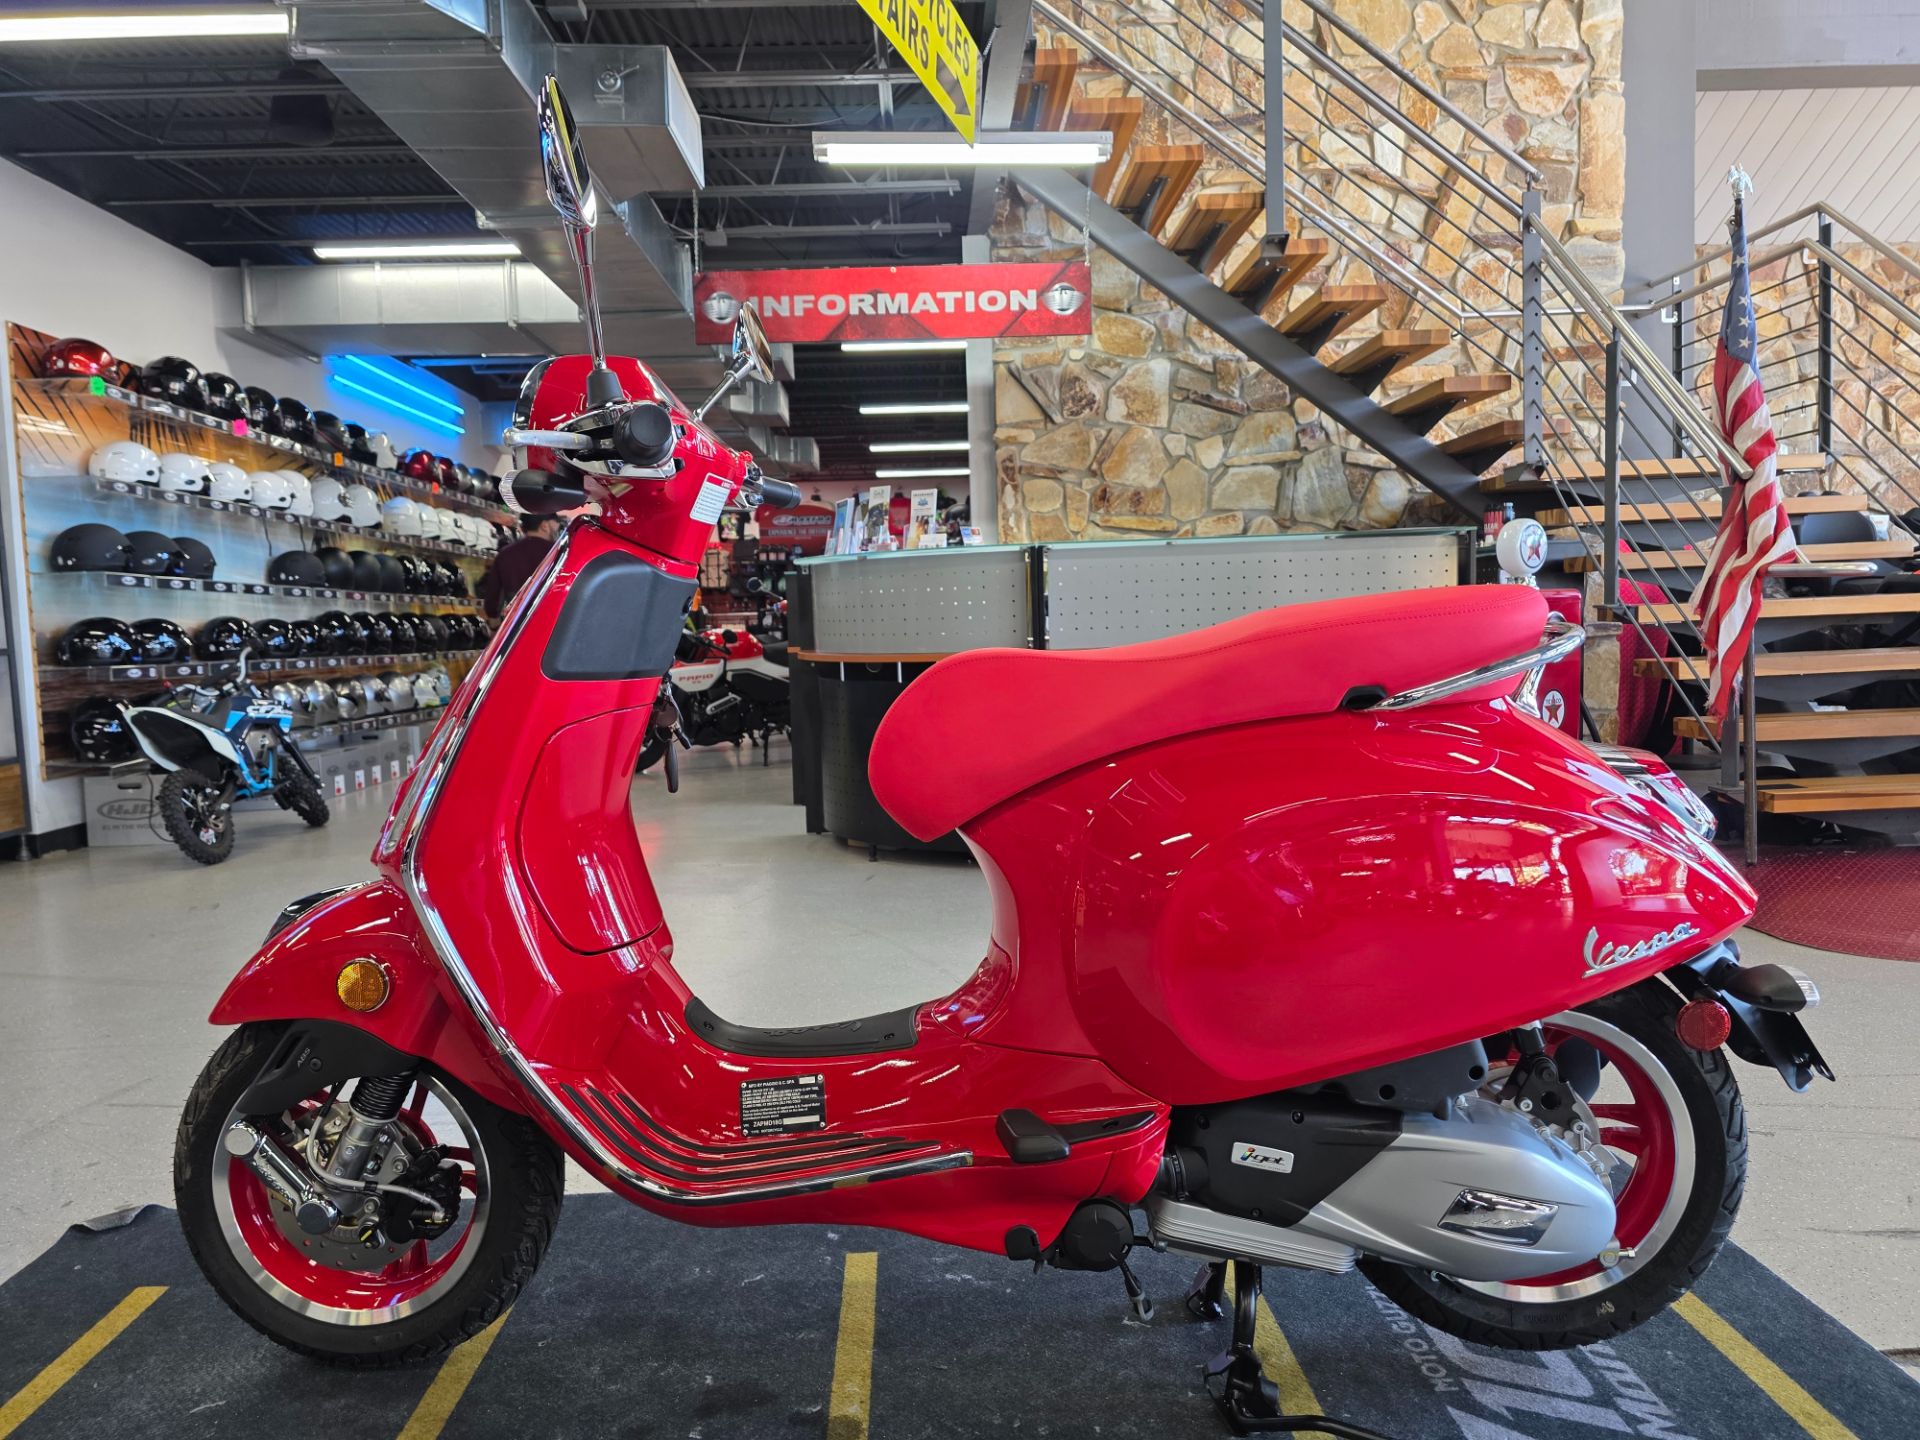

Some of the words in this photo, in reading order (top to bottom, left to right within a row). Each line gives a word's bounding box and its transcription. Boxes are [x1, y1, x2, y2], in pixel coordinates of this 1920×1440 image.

[748, 288, 1038, 318] INFORMATION
[1581, 921, 1701, 979] Vespa
[1403, 1338, 1460, 1392] MOTO
